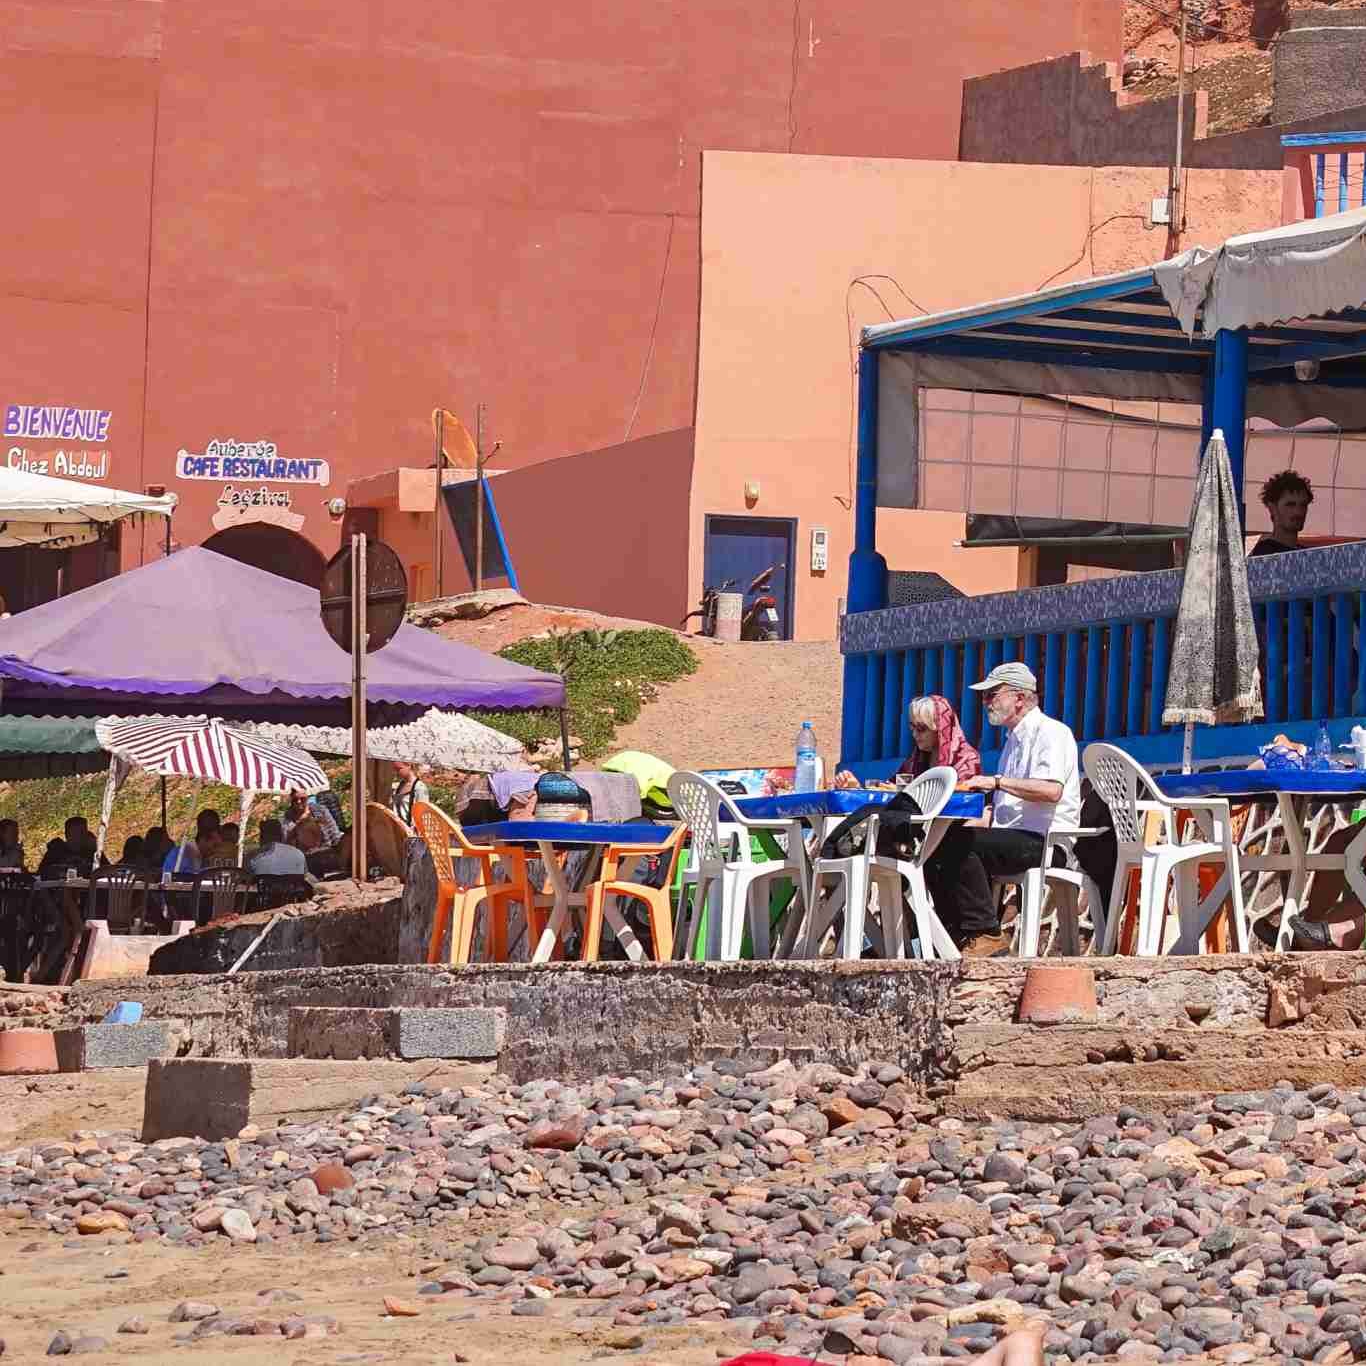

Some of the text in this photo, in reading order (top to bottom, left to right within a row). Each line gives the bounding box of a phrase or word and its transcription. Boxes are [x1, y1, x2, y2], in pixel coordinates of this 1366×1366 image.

[4, 405, 112, 442] BIENVENUE
[8, 447, 106, 478] Chez Abdoul
[183, 456, 323, 480] CAFE RESTAURANT
